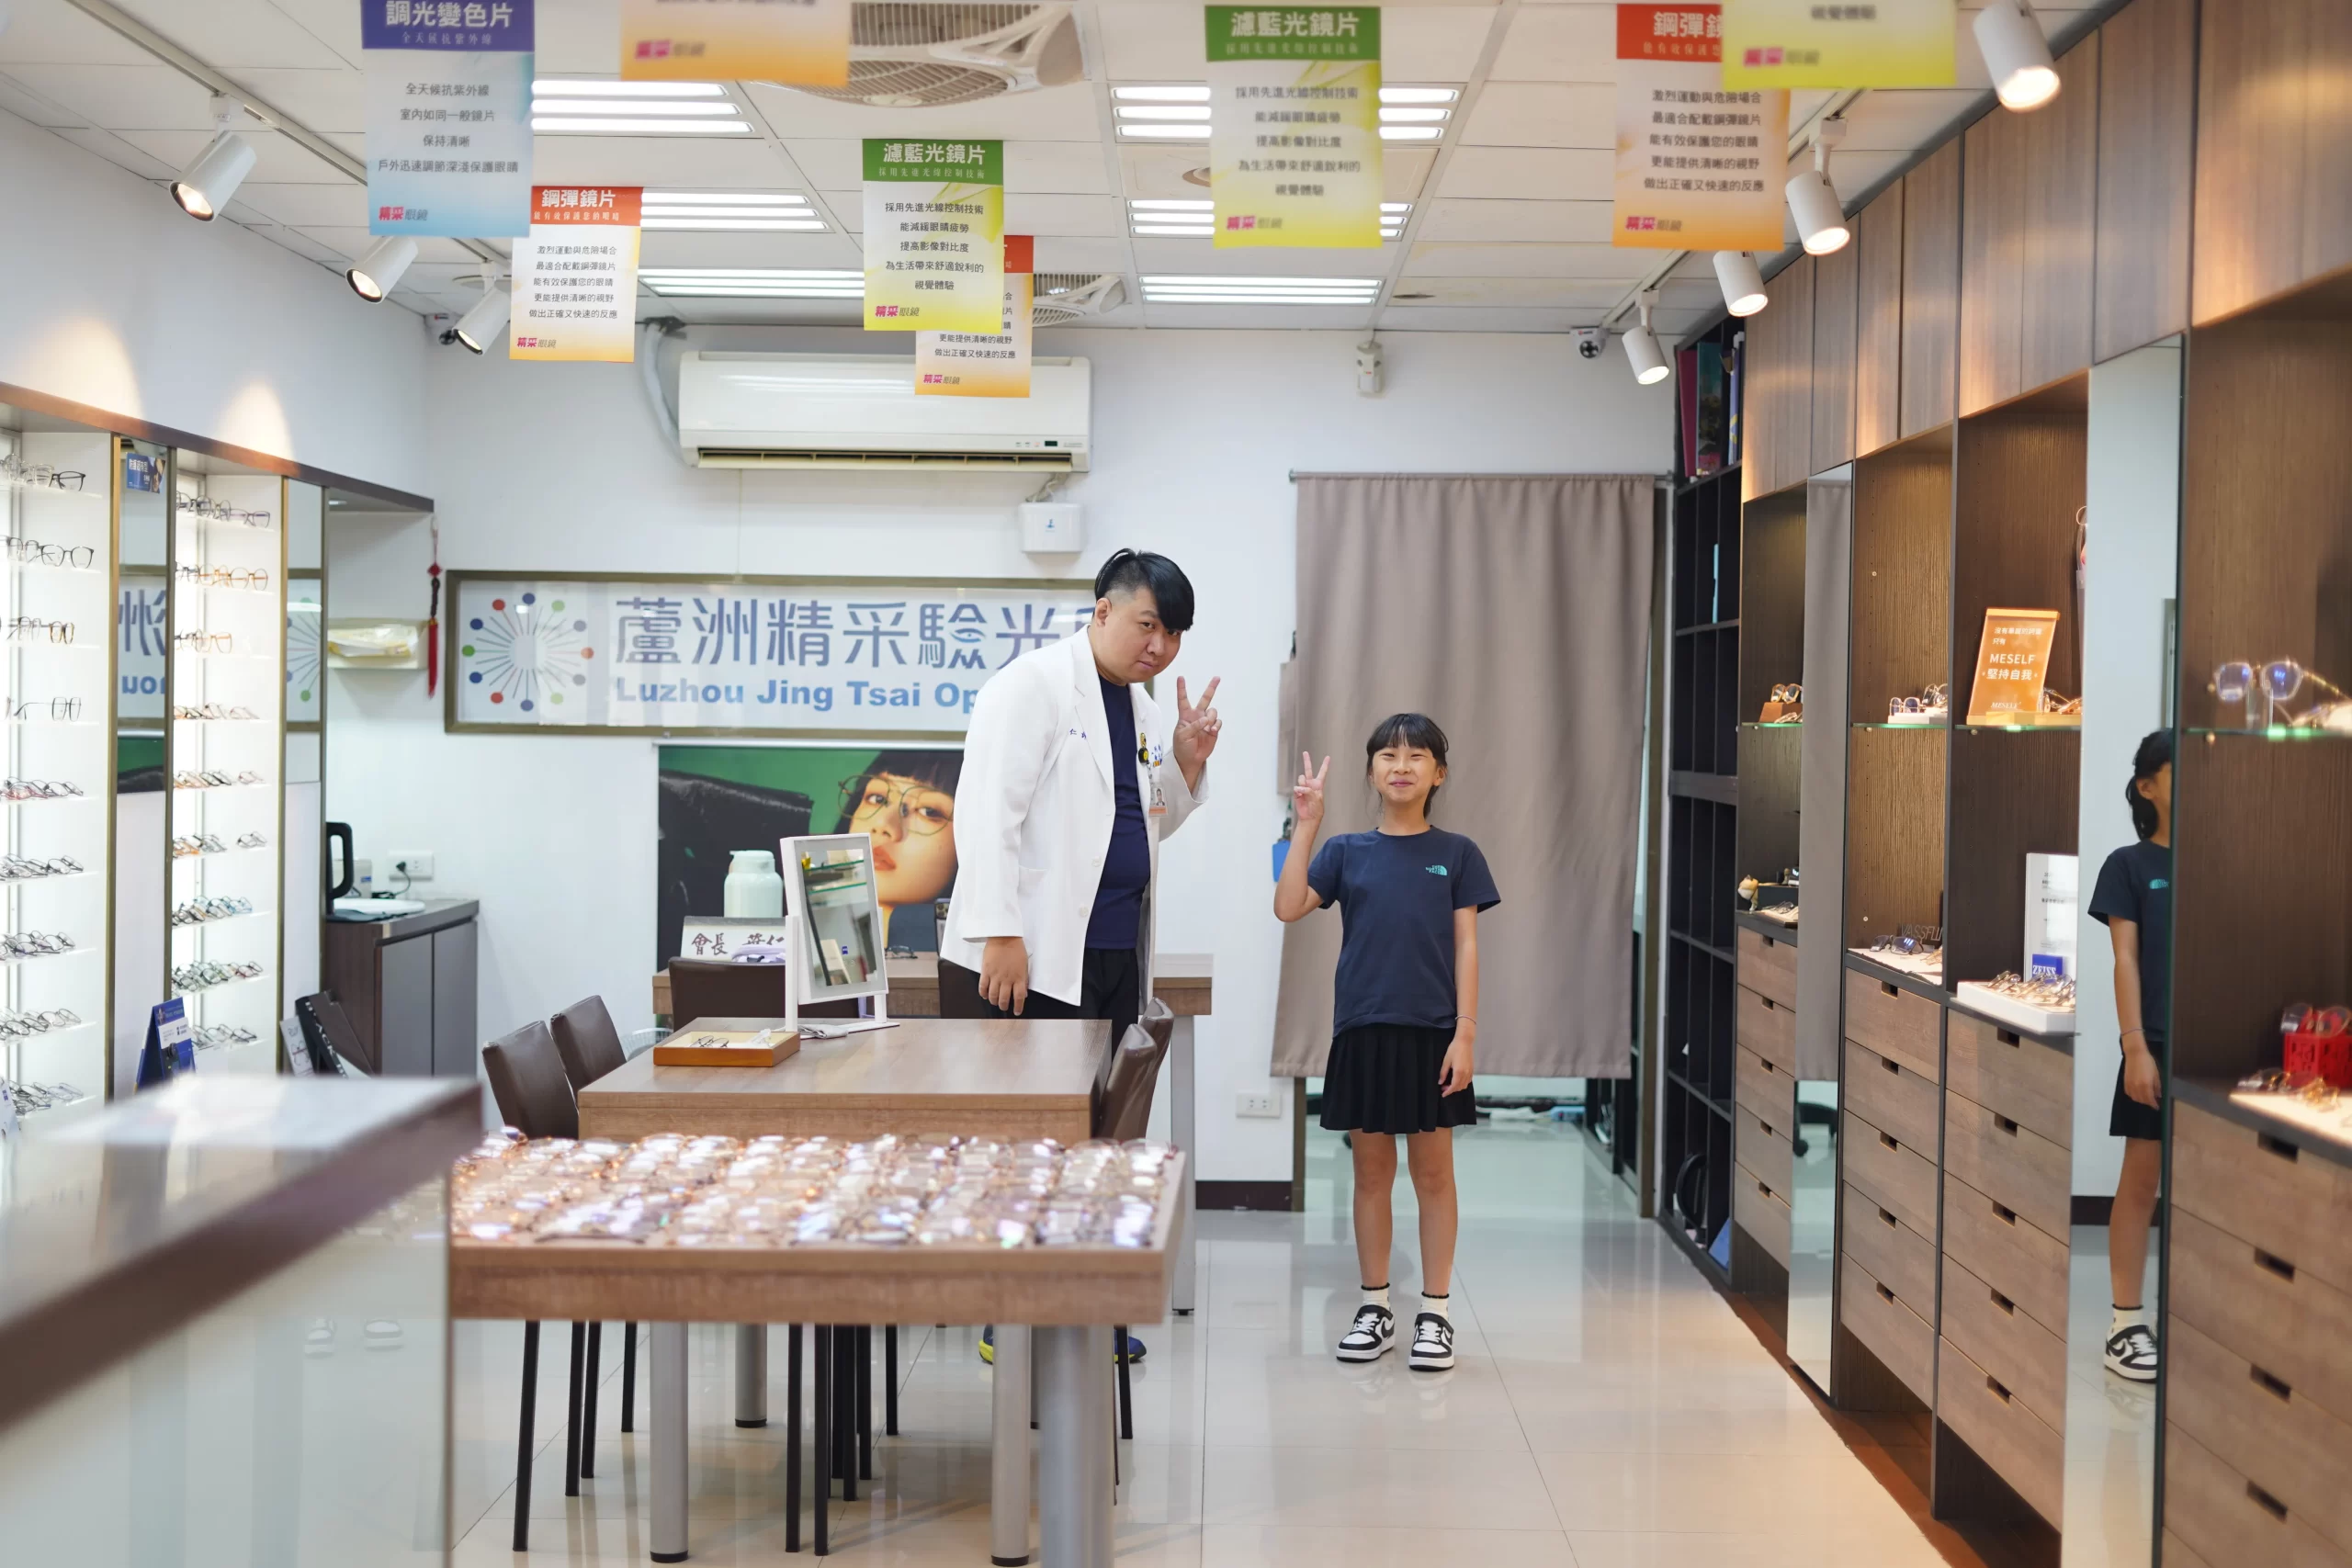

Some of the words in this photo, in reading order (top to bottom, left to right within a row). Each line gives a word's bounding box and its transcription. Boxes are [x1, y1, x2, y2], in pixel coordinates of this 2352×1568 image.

[386, 1, 513, 28] 調光變色片
[1231, 11, 1360, 38] 濾藍光鏡片
[405, 83, 490, 96] 全天候抗紫外線
[400, 108, 494, 122] 室內如同一般鏡片
[423, 135, 470, 148] 保持清晰
[883, 143, 986, 164] 濾藍光鏡片
[541, 189, 616, 208] 鋼彈鏡片
[885, 202, 984, 215] 採用先進光線控制技術
[899, 241, 969, 253] 提高影像對比度
[885, 261, 984, 273] 為生活帶來舒適銳利的
[914, 280, 955, 290] 視覺體驗
[939, 333, 1012, 344] 更能提供清晰的視野
[934, 348, 1016, 359] 做出正確又快速的反應
[616, 596, 1094, 671] 蘆洲精采驗光
[1989, 653, 2036, 664] MESELF
[616, 677, 744, 704] Luzhou
[757, 680, 833, 712] Jing
[846, 680, 920, 706] Tsai
[691, 932, 729, 955] 會長
[2032, 964, 2056, 976] ZEISS
